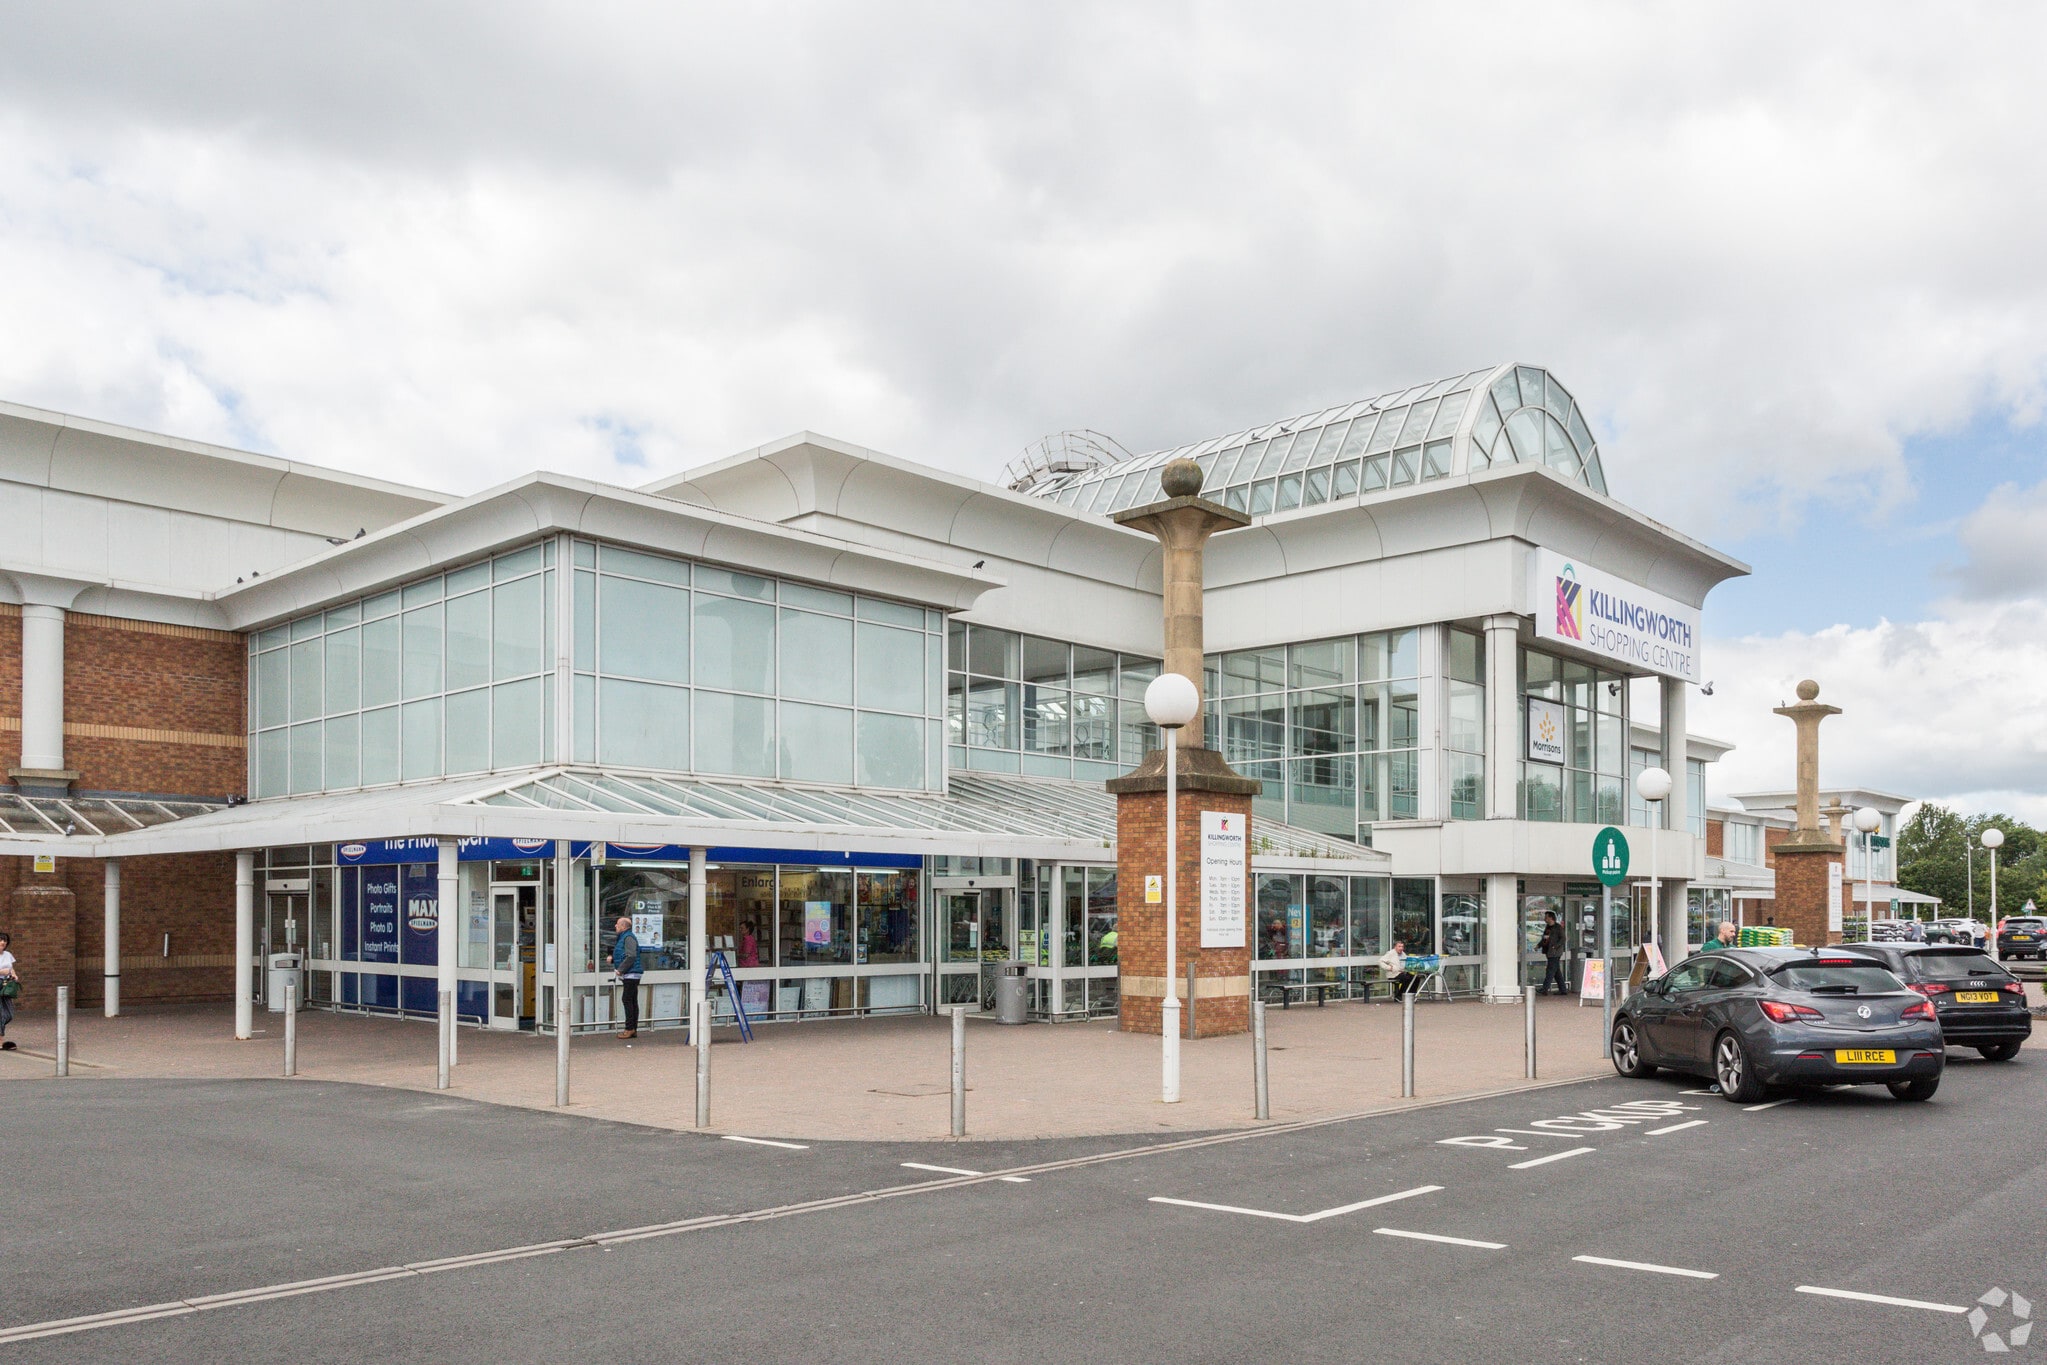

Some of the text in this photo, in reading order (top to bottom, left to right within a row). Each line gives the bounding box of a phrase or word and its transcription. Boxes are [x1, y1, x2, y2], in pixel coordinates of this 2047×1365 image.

[1590, 588, 1692, 648] KILLINGWORTH
[1589, 623, 1691, 676] SHOPPING CENTRE
[1533, 740, 1561, 754] Morrisons
[1207, 834, 1242, 842] KILLINGWORTH
[1207, 857, 1242, 866] Opening Hours
[367, 883, 397, 894] Photo Gifts
[370, 902, 393, 914] Portraits
[408, 899, 438, 917] MAX
[370, 921, 393, 933] Photo ID
[364, 941, 383, 952] Instant
[1865, 1051, 1886, 1061] RCE
